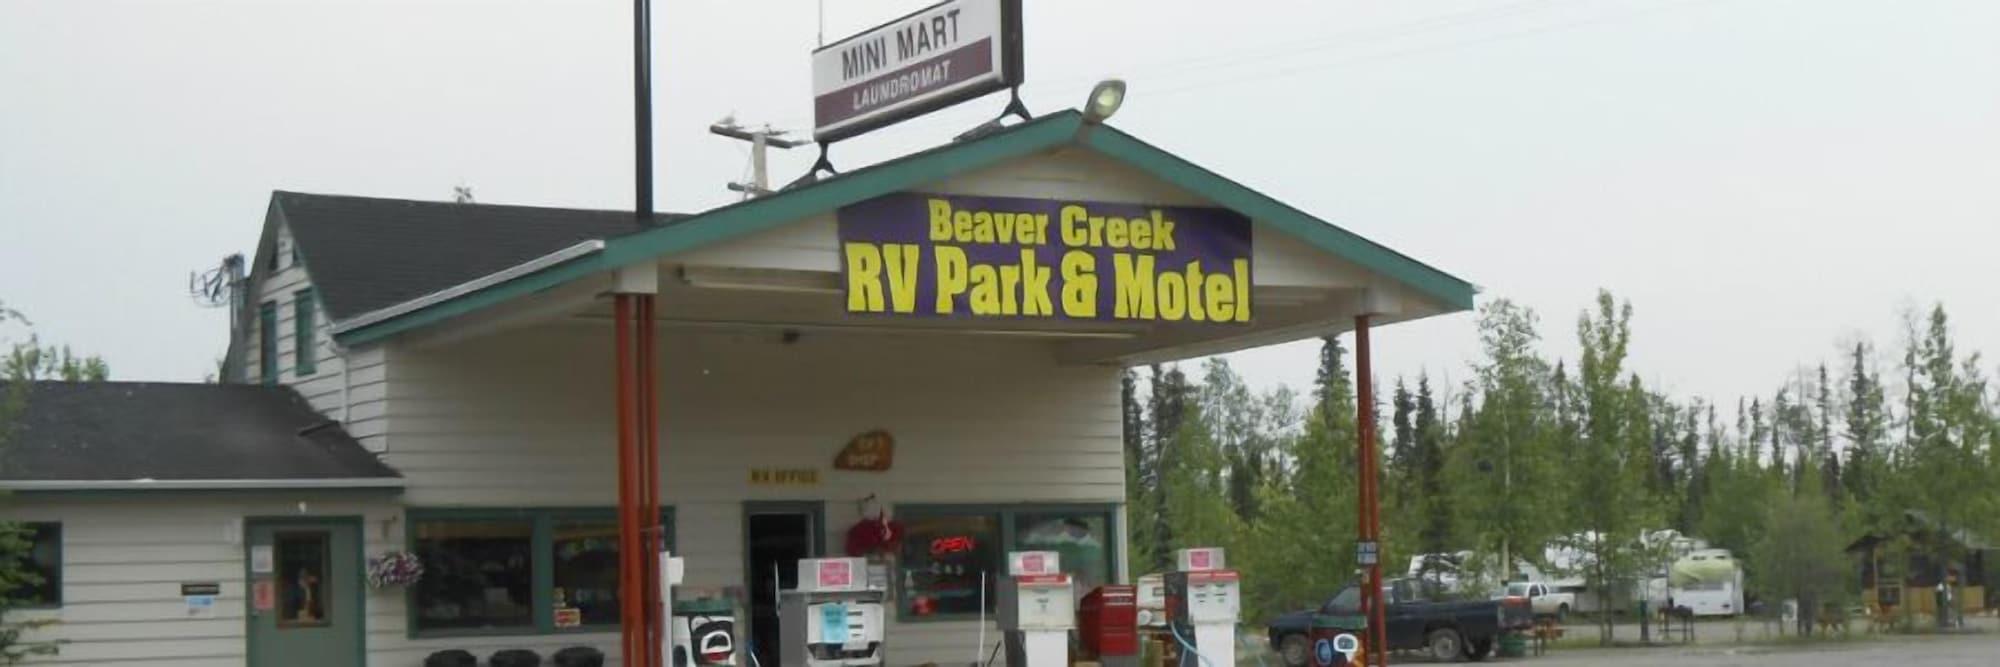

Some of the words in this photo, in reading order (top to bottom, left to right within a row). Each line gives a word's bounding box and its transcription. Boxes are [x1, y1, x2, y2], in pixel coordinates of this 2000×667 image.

[842, 36, 887, 81] MINI
[896, 8, 961, 62] MART
[853, 59, 952, 110] LAUNDROMAT
[928, 198, 1049, 246] Beaver
[1060, 204, 1176, 251] Creek
[845, 242, 920, 313] RV
[935, 245, 1054, 316] Park
[1060, 250, 1099, 318] &
[1112, 252, 1251, 323] Motel
[930, 536, 976, 555] OPEN
